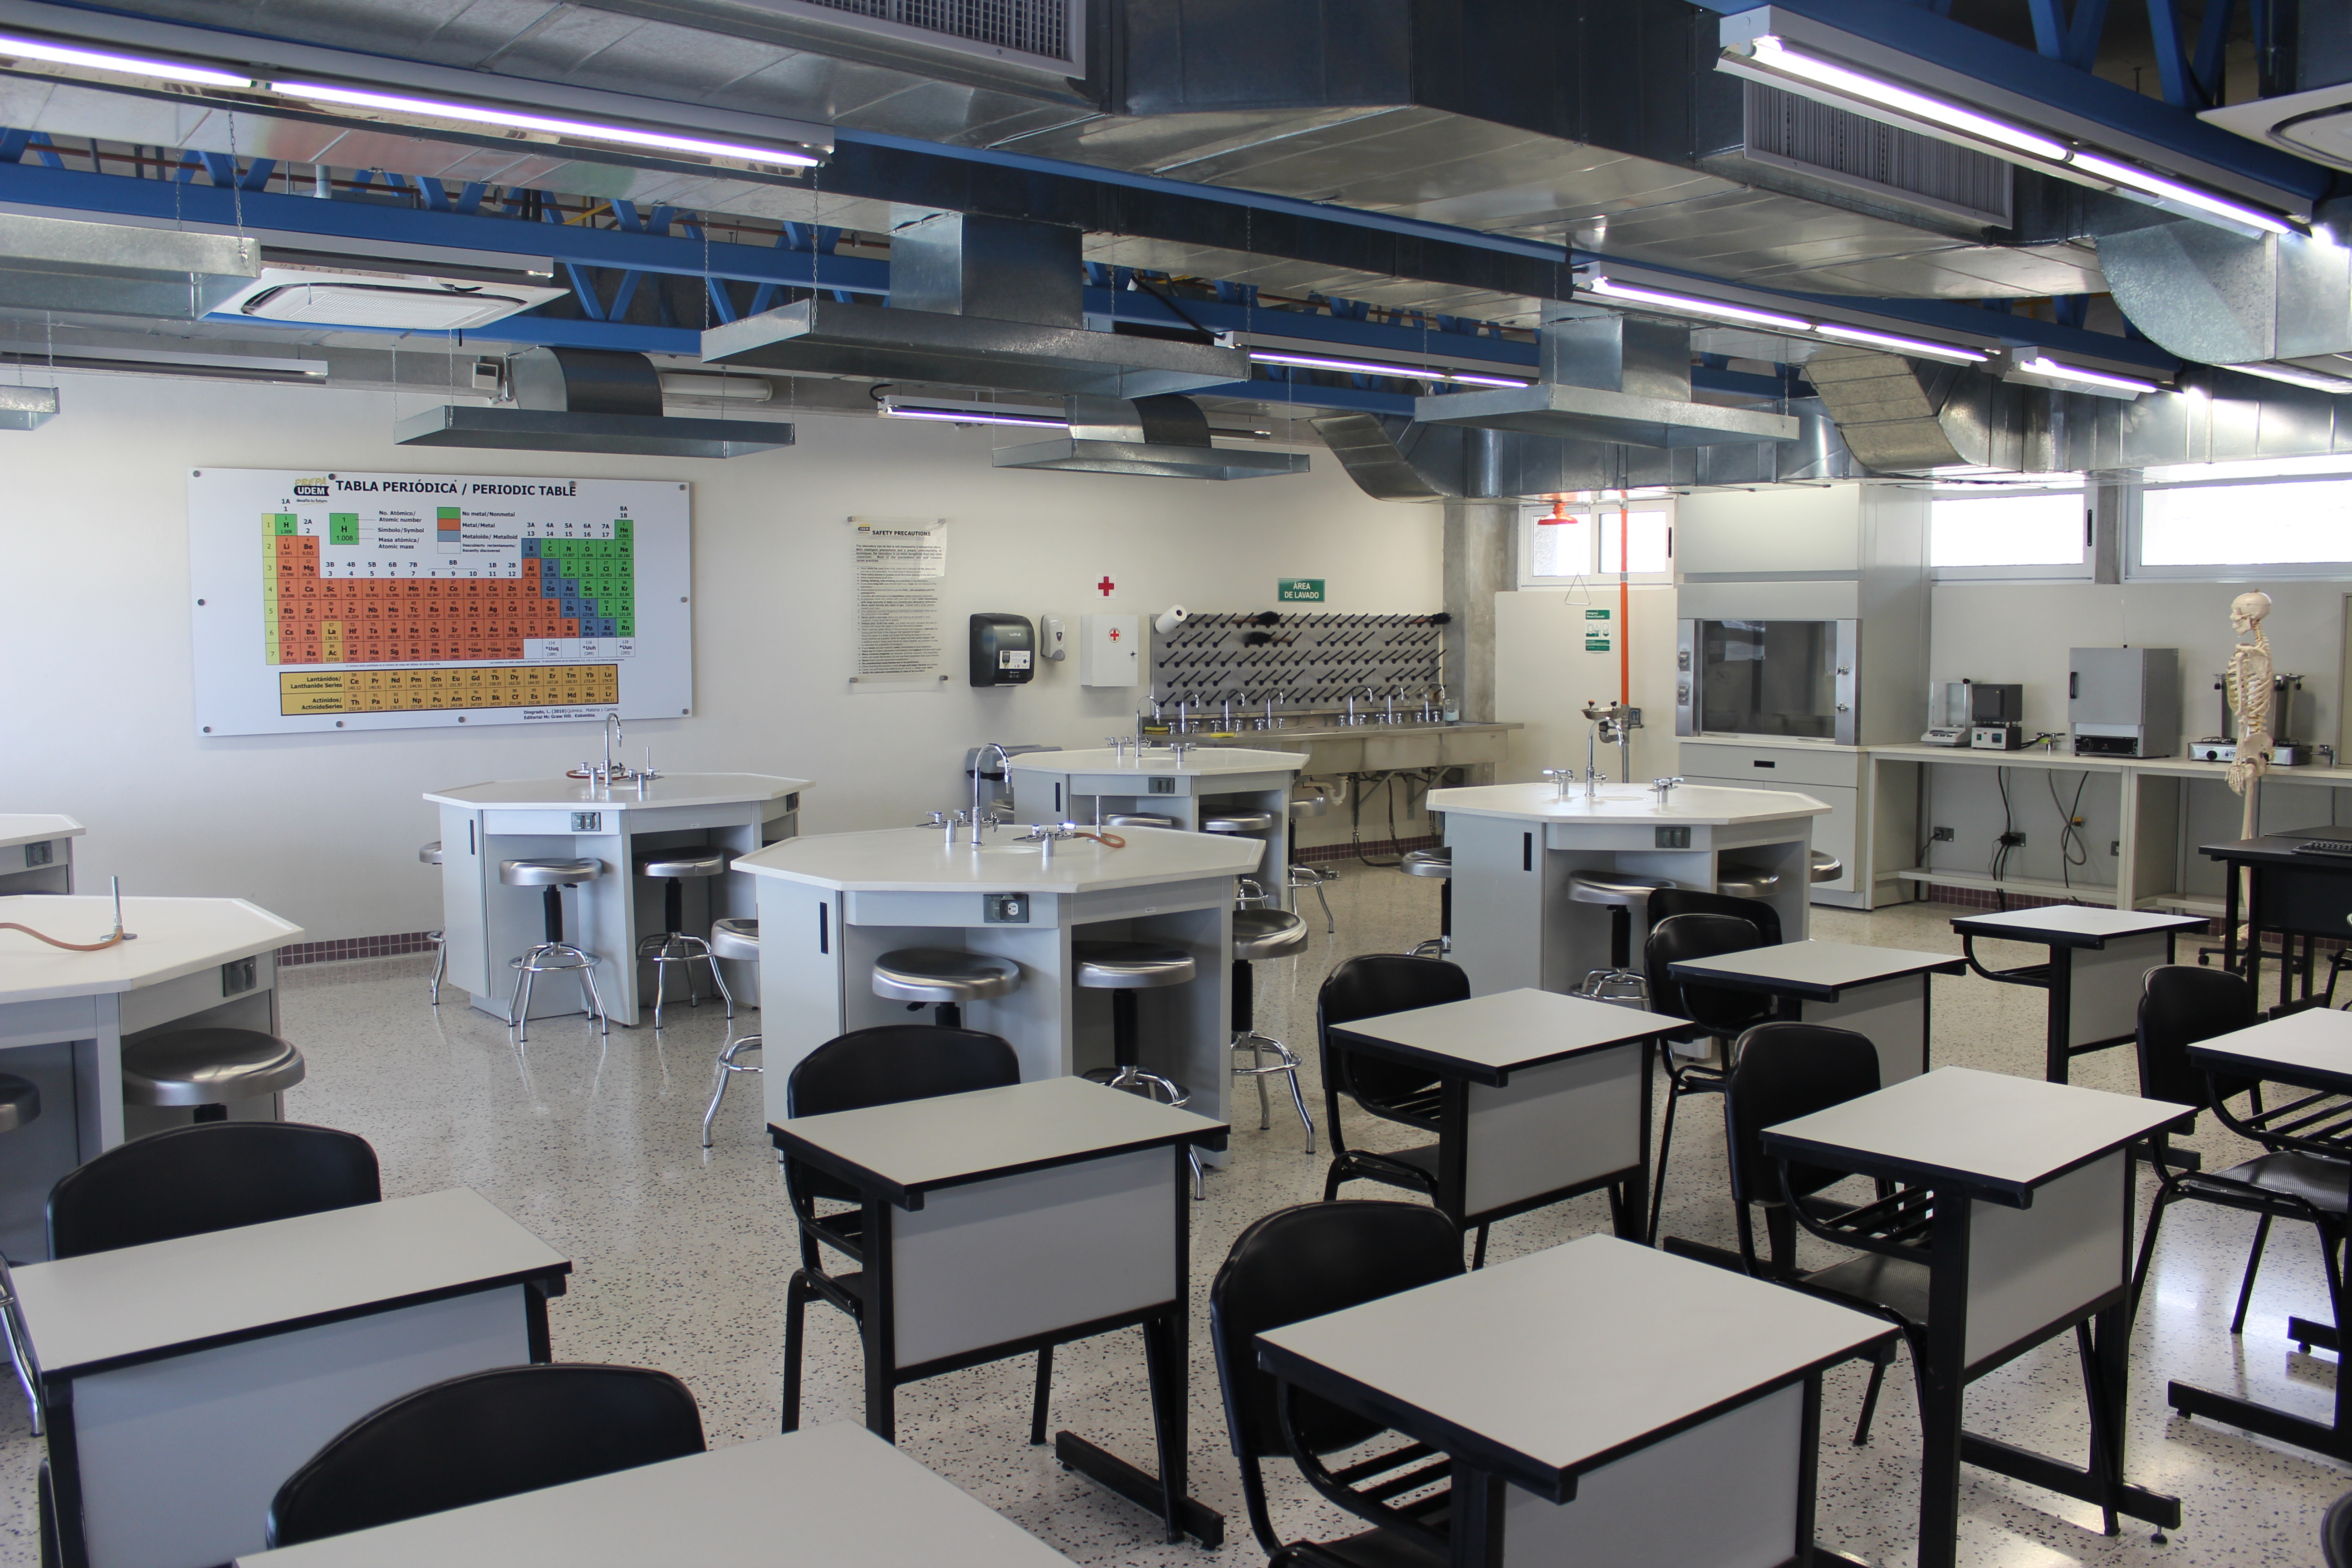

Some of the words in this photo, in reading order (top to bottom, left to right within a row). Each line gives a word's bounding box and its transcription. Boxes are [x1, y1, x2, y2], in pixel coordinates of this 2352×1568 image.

[336, 480, 378, 492] TABLA
[383, 479, 457, 493] PERIÓDICA
[462, 483, 467, 495] /
[472, 484, 535, 495] PERIODIC
[539, 485, 576, 496] TABLE
[1294, 581, 1310, 590] ÁREA
